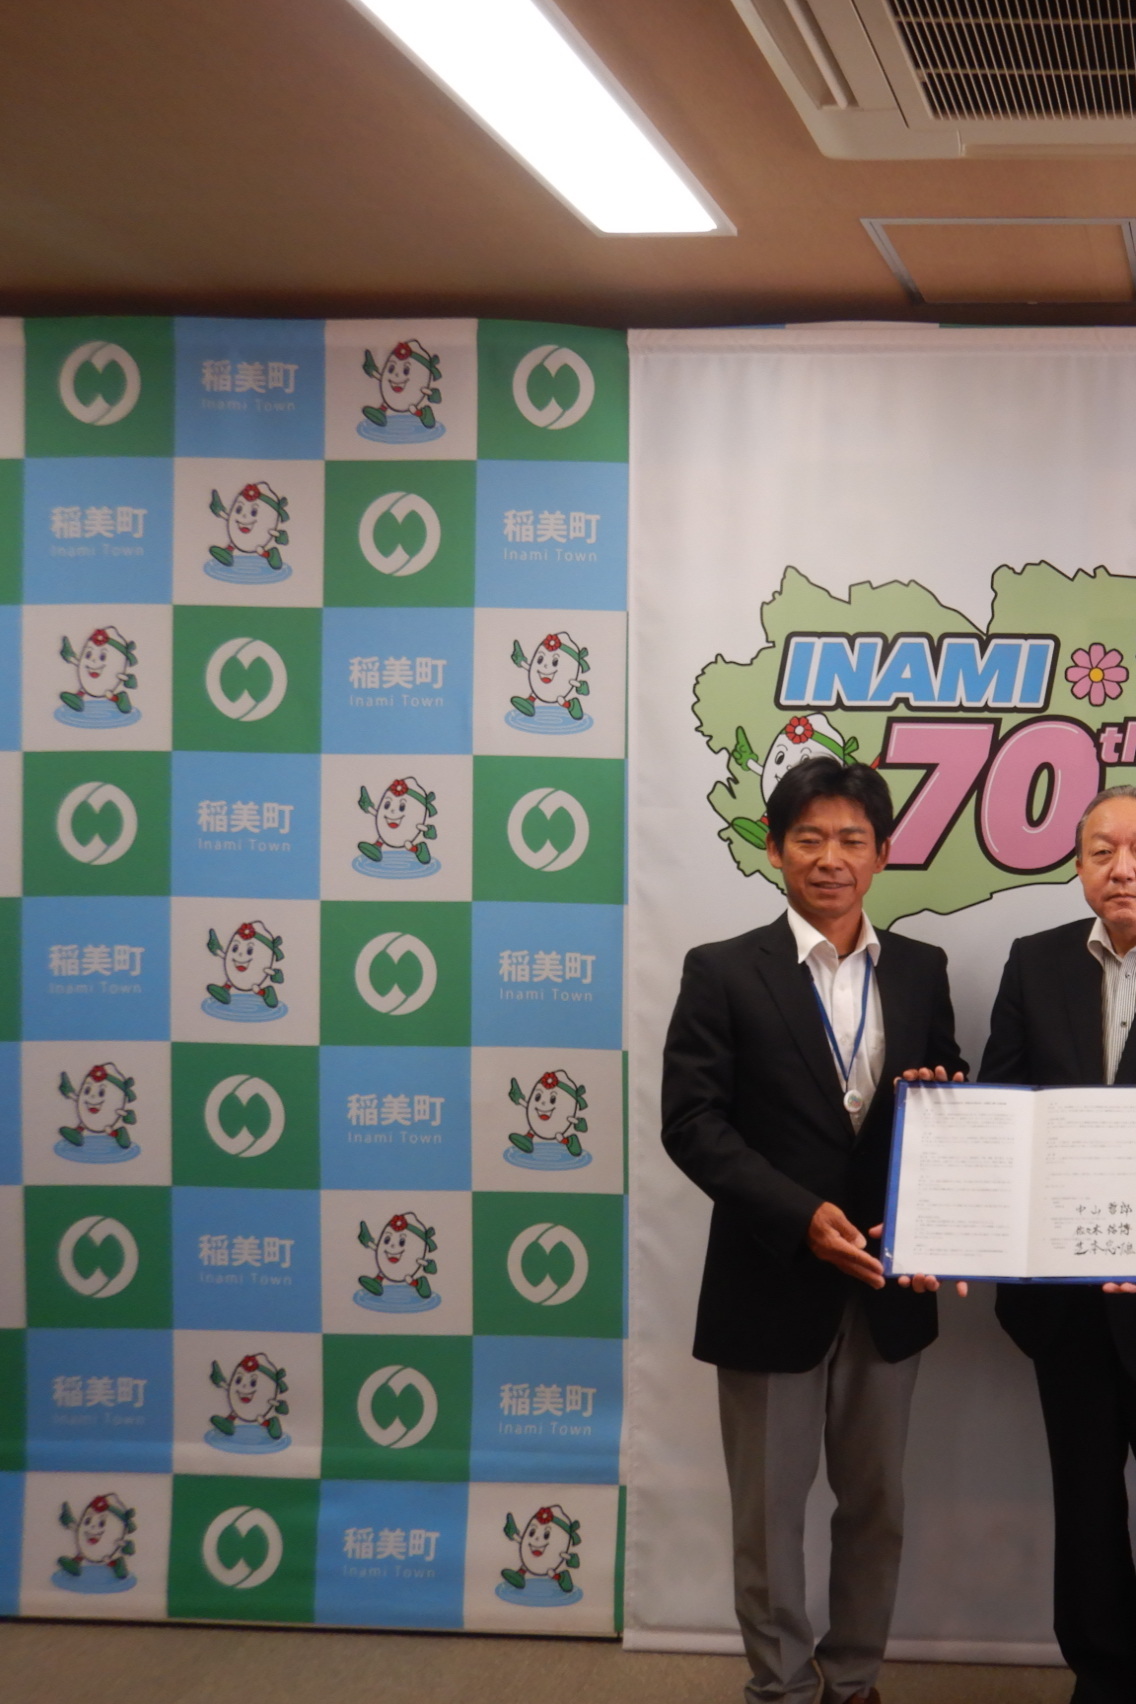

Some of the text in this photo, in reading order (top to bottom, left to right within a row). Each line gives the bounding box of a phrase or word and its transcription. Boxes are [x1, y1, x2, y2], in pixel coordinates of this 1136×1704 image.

[202, 360, 298, 393] 稲美町
[51, 506, 147, 538] 稲美町
[504, 510, 600, 544] 稲美町
[503, 548, 597, 562] Inami Town
[349, 657, 447, 689] 稲美町
[777, 634, 1059, 712] INAMI
[349, 694, 444, 707] Inami Town
[198, 800, 294, 834] 稲美町
[198, 838, 291, 851] Inami Town
[49, 945, 144, 976] 稲美町
[499, 950, 596, 984] 稲美町
[500, 988, 593, 1001] Inami Town
[347, 1094, 445, 1126] 稲美町
[348, 1131, 442, 1144] Inami Town
[199, 1235, 294, 1268] 稲美町
[53, 1376, 147, 1407] 稲美町
[500, 1384, 597, 1416] 稲美町
[499, 1421, 592, 1436] Inami Town
[344, 1527, 439, 1561] 稲美町
